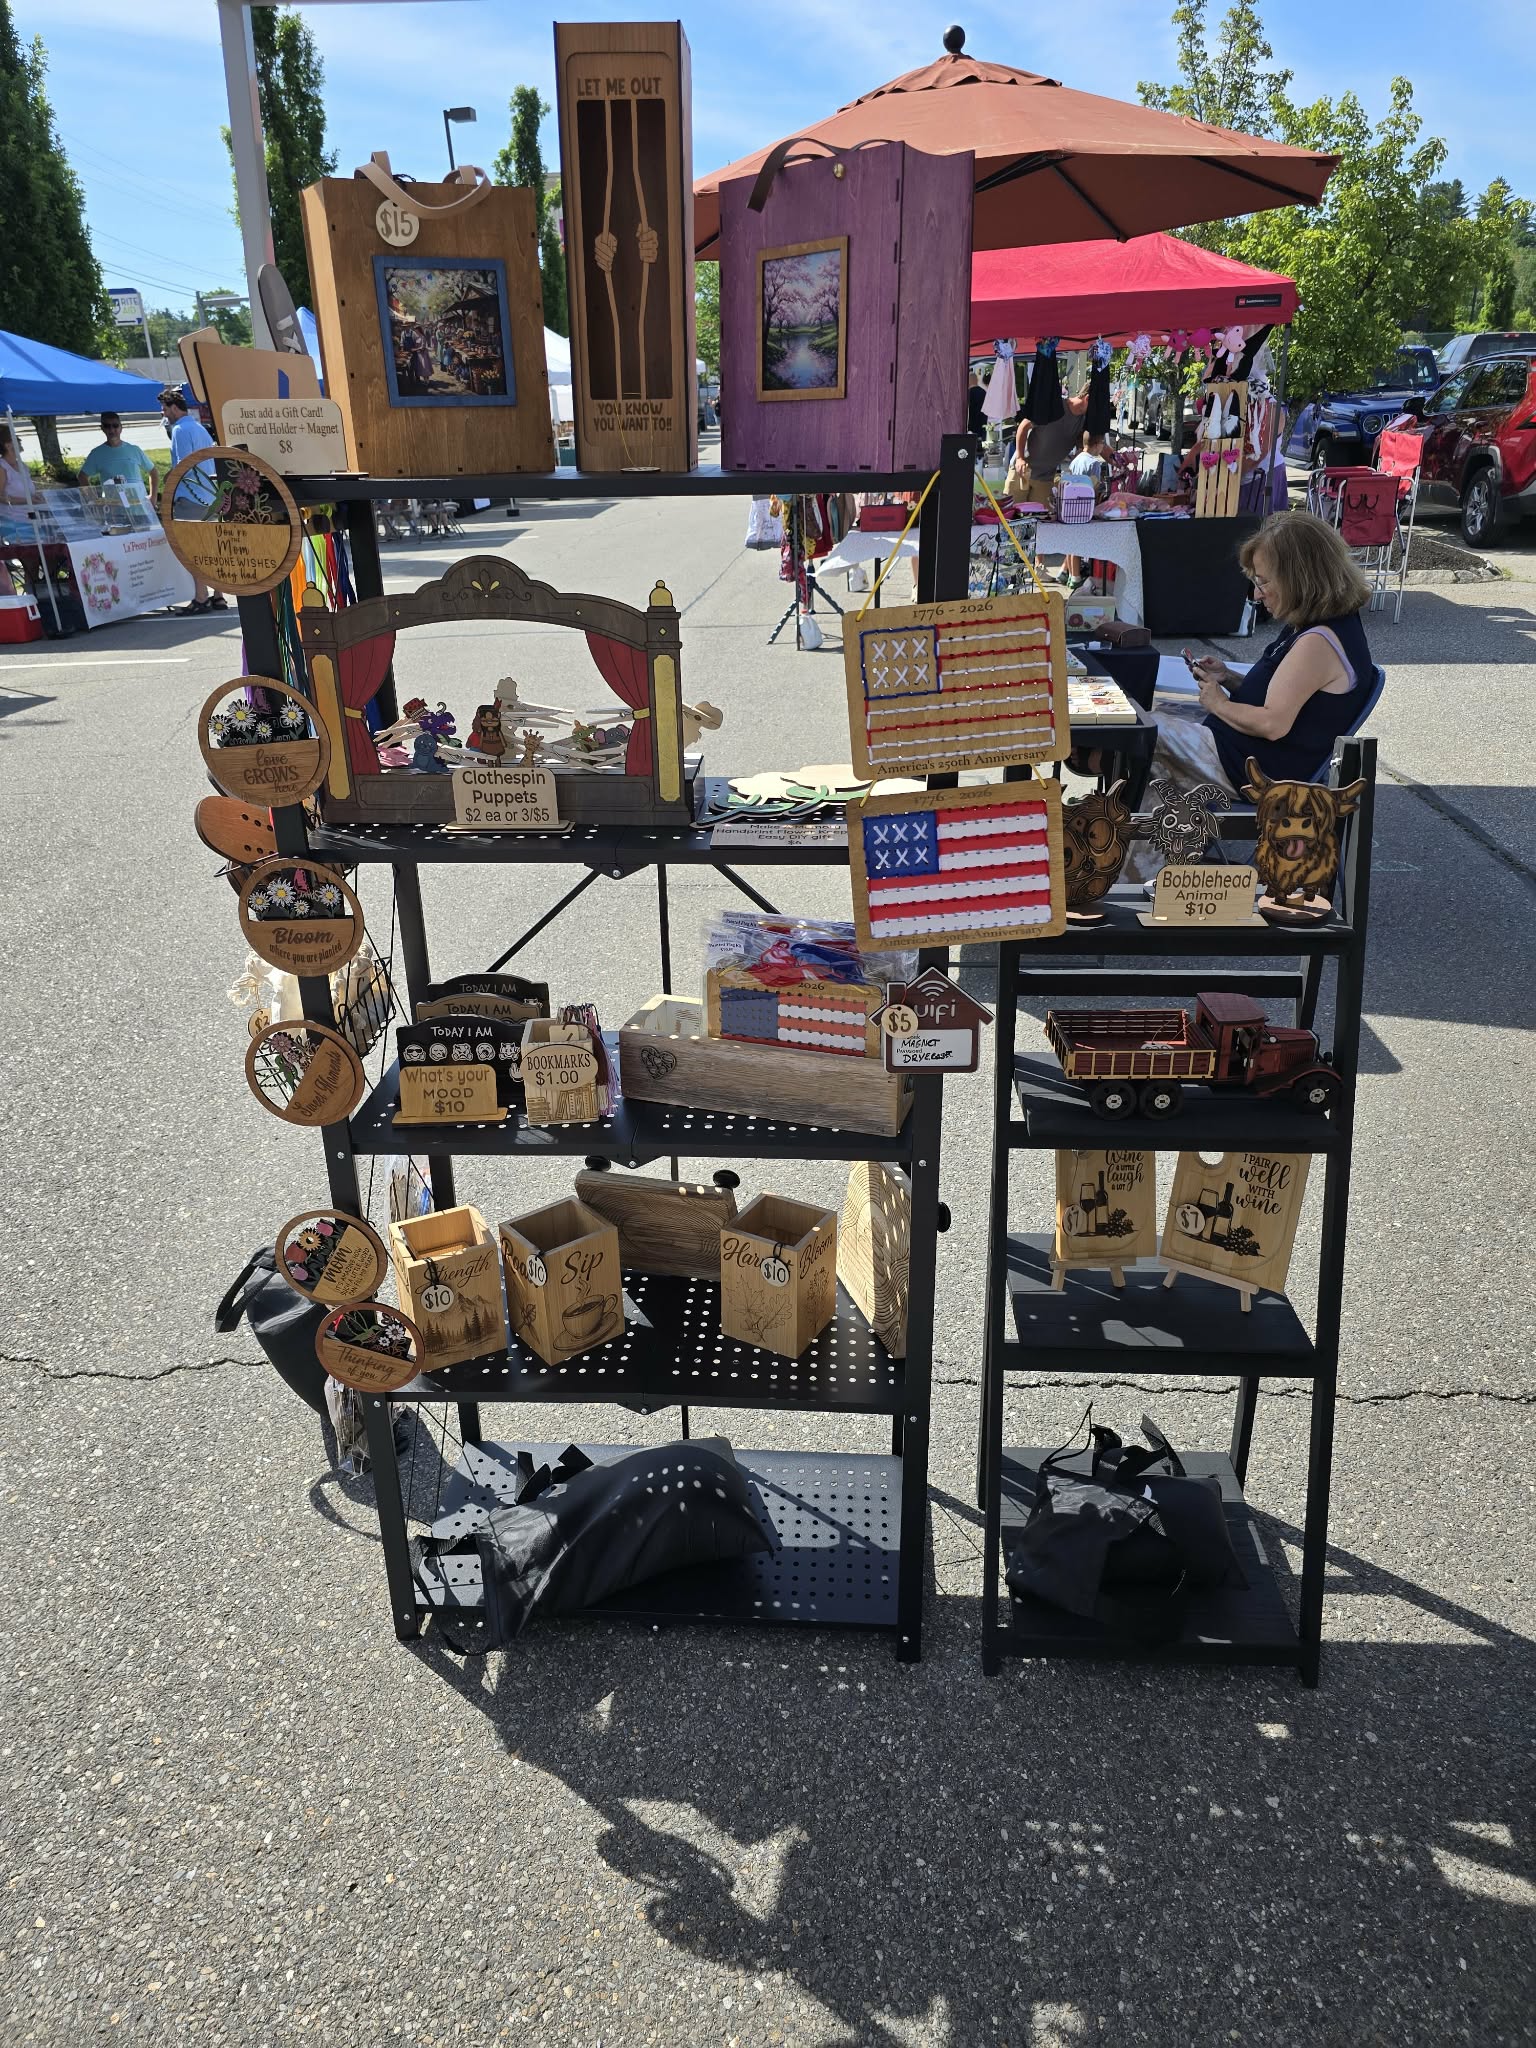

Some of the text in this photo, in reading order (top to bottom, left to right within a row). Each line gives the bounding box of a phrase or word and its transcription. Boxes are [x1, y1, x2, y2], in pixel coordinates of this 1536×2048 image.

[577, 77, 662, 96] LET ME OUT
[380, 208, 413, 239] $15
[240, 406, 324, 418] Just add a Gift Card!
[598, 402, 663, 416] YOU KNOW
[228, 422, 246, 435] Gift
[247, 422, 267, 435] Card
[269, 421, 297, 435] Holder
[307, 421, 339, 437] Magnet
[593, 417, 672, 432] YOU WANT TO!!
[279, 439, 293, 454] $8
[217, 539, 249, 556] Mom
[194, 556, 277, 569] EVERYONE WISHES
[216, 568, 257, 584] they had
[912, 604, 944, 622] 1776
[959, 600, 994, 614] 2026
[256, 748, 288, 767] love
[877, 750, 1048, 775] America's 250th Anniversary
[243, 765, 299, 785] GROWS
[462, 769, 546, 787] Clothespin
[274, 780, 298, 793] here
[472, 789, 538, 807] Puppets
[914, 792, 945, 807] 1776
[959, 789, 993, 801] 2026
[465, 807, 550, 822] $2 ea or 3/$5
[1162, 870, 1252, 889] Bobblehead
[1175, 889, 1228, 901] Animal
[1185, 901, 1217, 916] $10
[272, 927, 334, 945] Bloom
[880, 933, 934, 948] America's
[974, 926, 1044, 940] Anniversary
[269, 940, 343, 965] where you are planted
[460, 983, 517, 993] TODAY I AM
[798, 981, 825, 991] 2026
[444, 1003, 481, 1016] TODAY
[493, 1004, 512, 1015] AM
[888, 1011, 911, 1034] $5
[430, 1026, 493, 1038] TODAY I AM
[901, 1038, 941, 1049] MAGNET
[527, 1053, 591, 1071] BOOKMARKS
[405, 1068, 490, 1086] What's your
[535, 1071, 579, 1086] $1.00
[423, 1087, 474, 1099] MOOD
[434, 1100, 465, 1115] $10
[1106, 1149, 1144, 1165] Wine
[1243, 1153, 1271, 1169] I PAIR
[1107, 1162, 1144, 1192] laugh
[1239, 1161, 1291, 1190] well
[1117, 1183, 1126, 1191] LOT
[1248, 1183, 1275, 1199] WITH
[1236, 1194, 1282, 1215] wine
[1067, 1209, 1079, 1231] $7
[1180, 1209, 1199, 1230] $7
[502, 1236, 530, 1280] Roa
[723, 1238, 794, 1268] Hart
[800, 1233, 833, 1279] Bloom
[415, 1250, 494, 1294] Strength
[529, 1258, 545, 1283] $10
[561, 1250, 604, 1285] Sip
[764, 1262, 786, 1283] $10
[424, 1290, 451, 1310] $10
[337, 1345, 397, 1381] Thinking
[347, 1366, 378, 1382] of you
